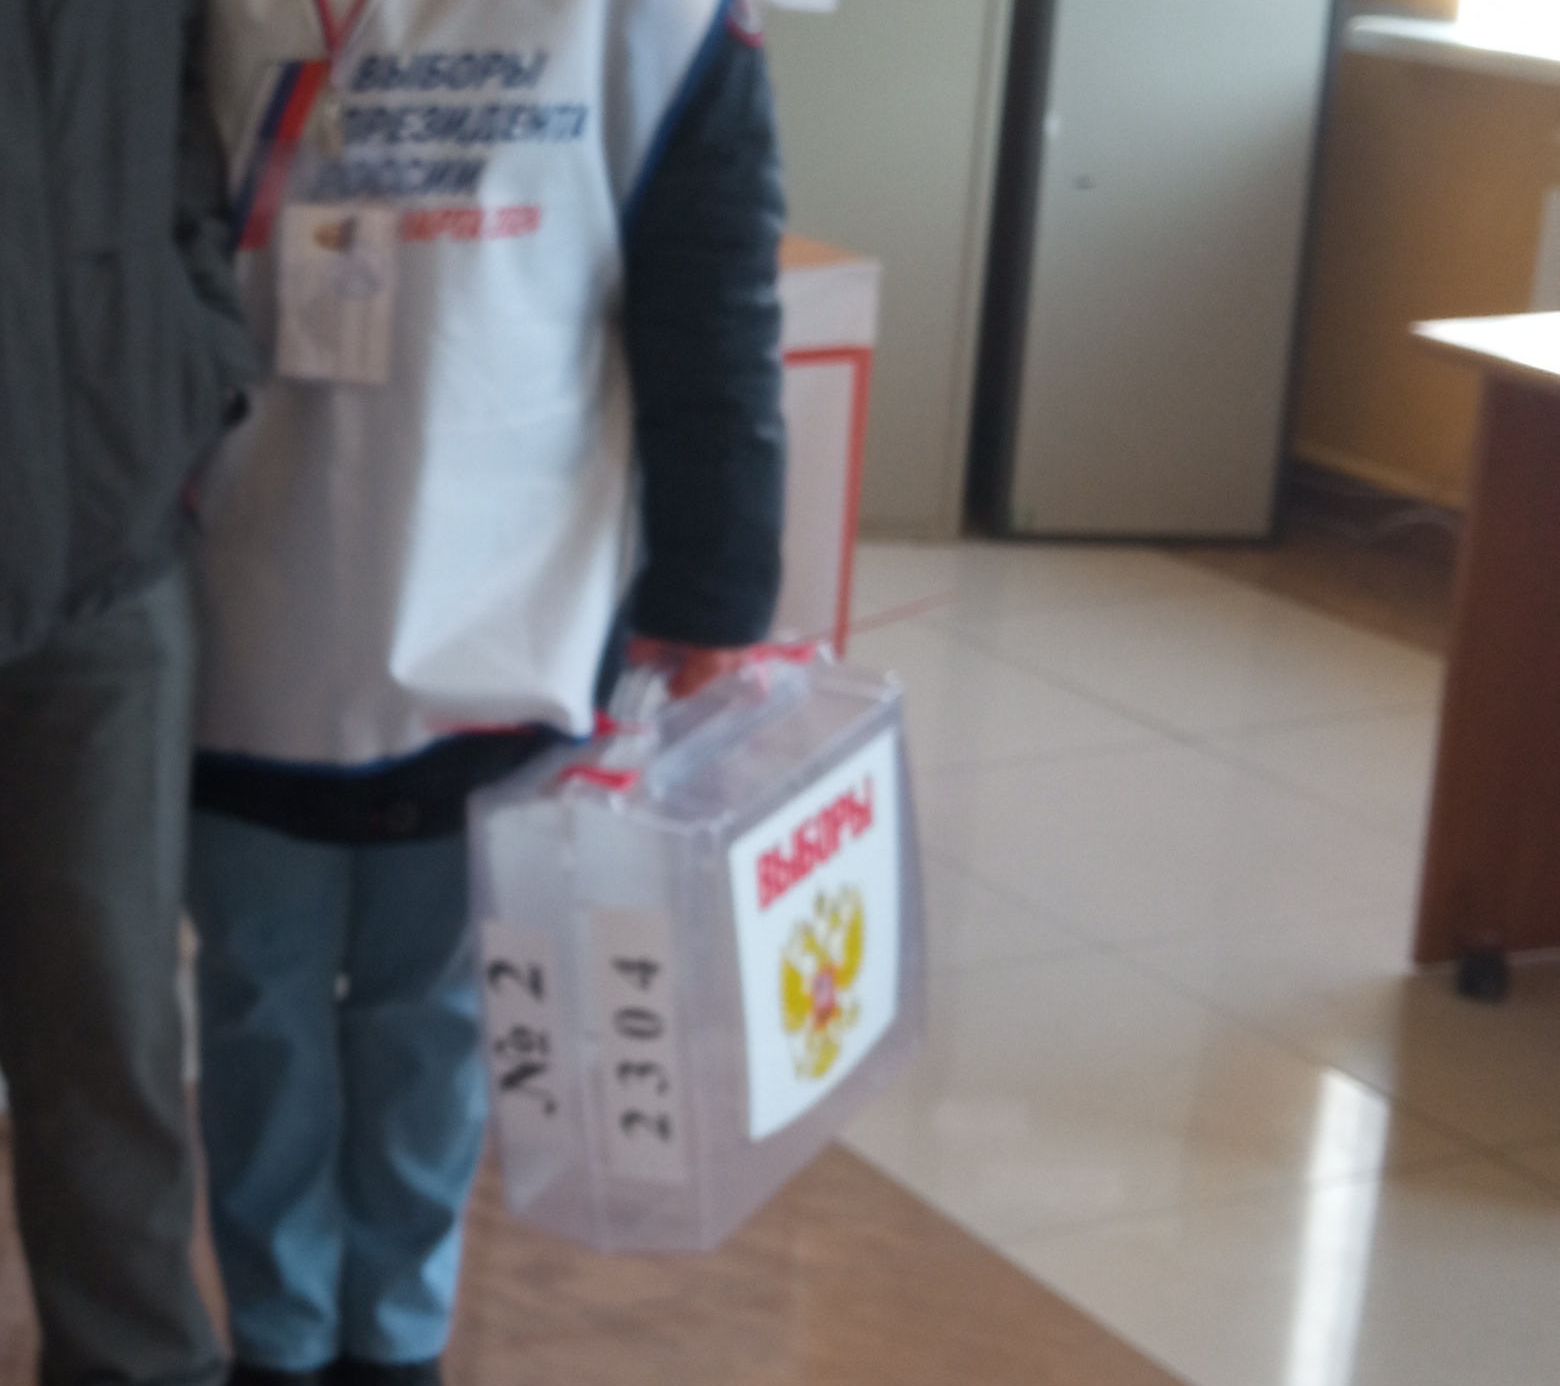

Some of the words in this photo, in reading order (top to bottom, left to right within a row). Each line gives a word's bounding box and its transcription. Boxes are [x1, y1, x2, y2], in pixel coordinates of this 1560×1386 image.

[352, 51, 549, 92] ВЫБОРЫ
[756, 773, 874, 911] ВЫБОРЫ
[487, 958, 545, 1003] 2
[608, 955, 673, 1144] 2304
